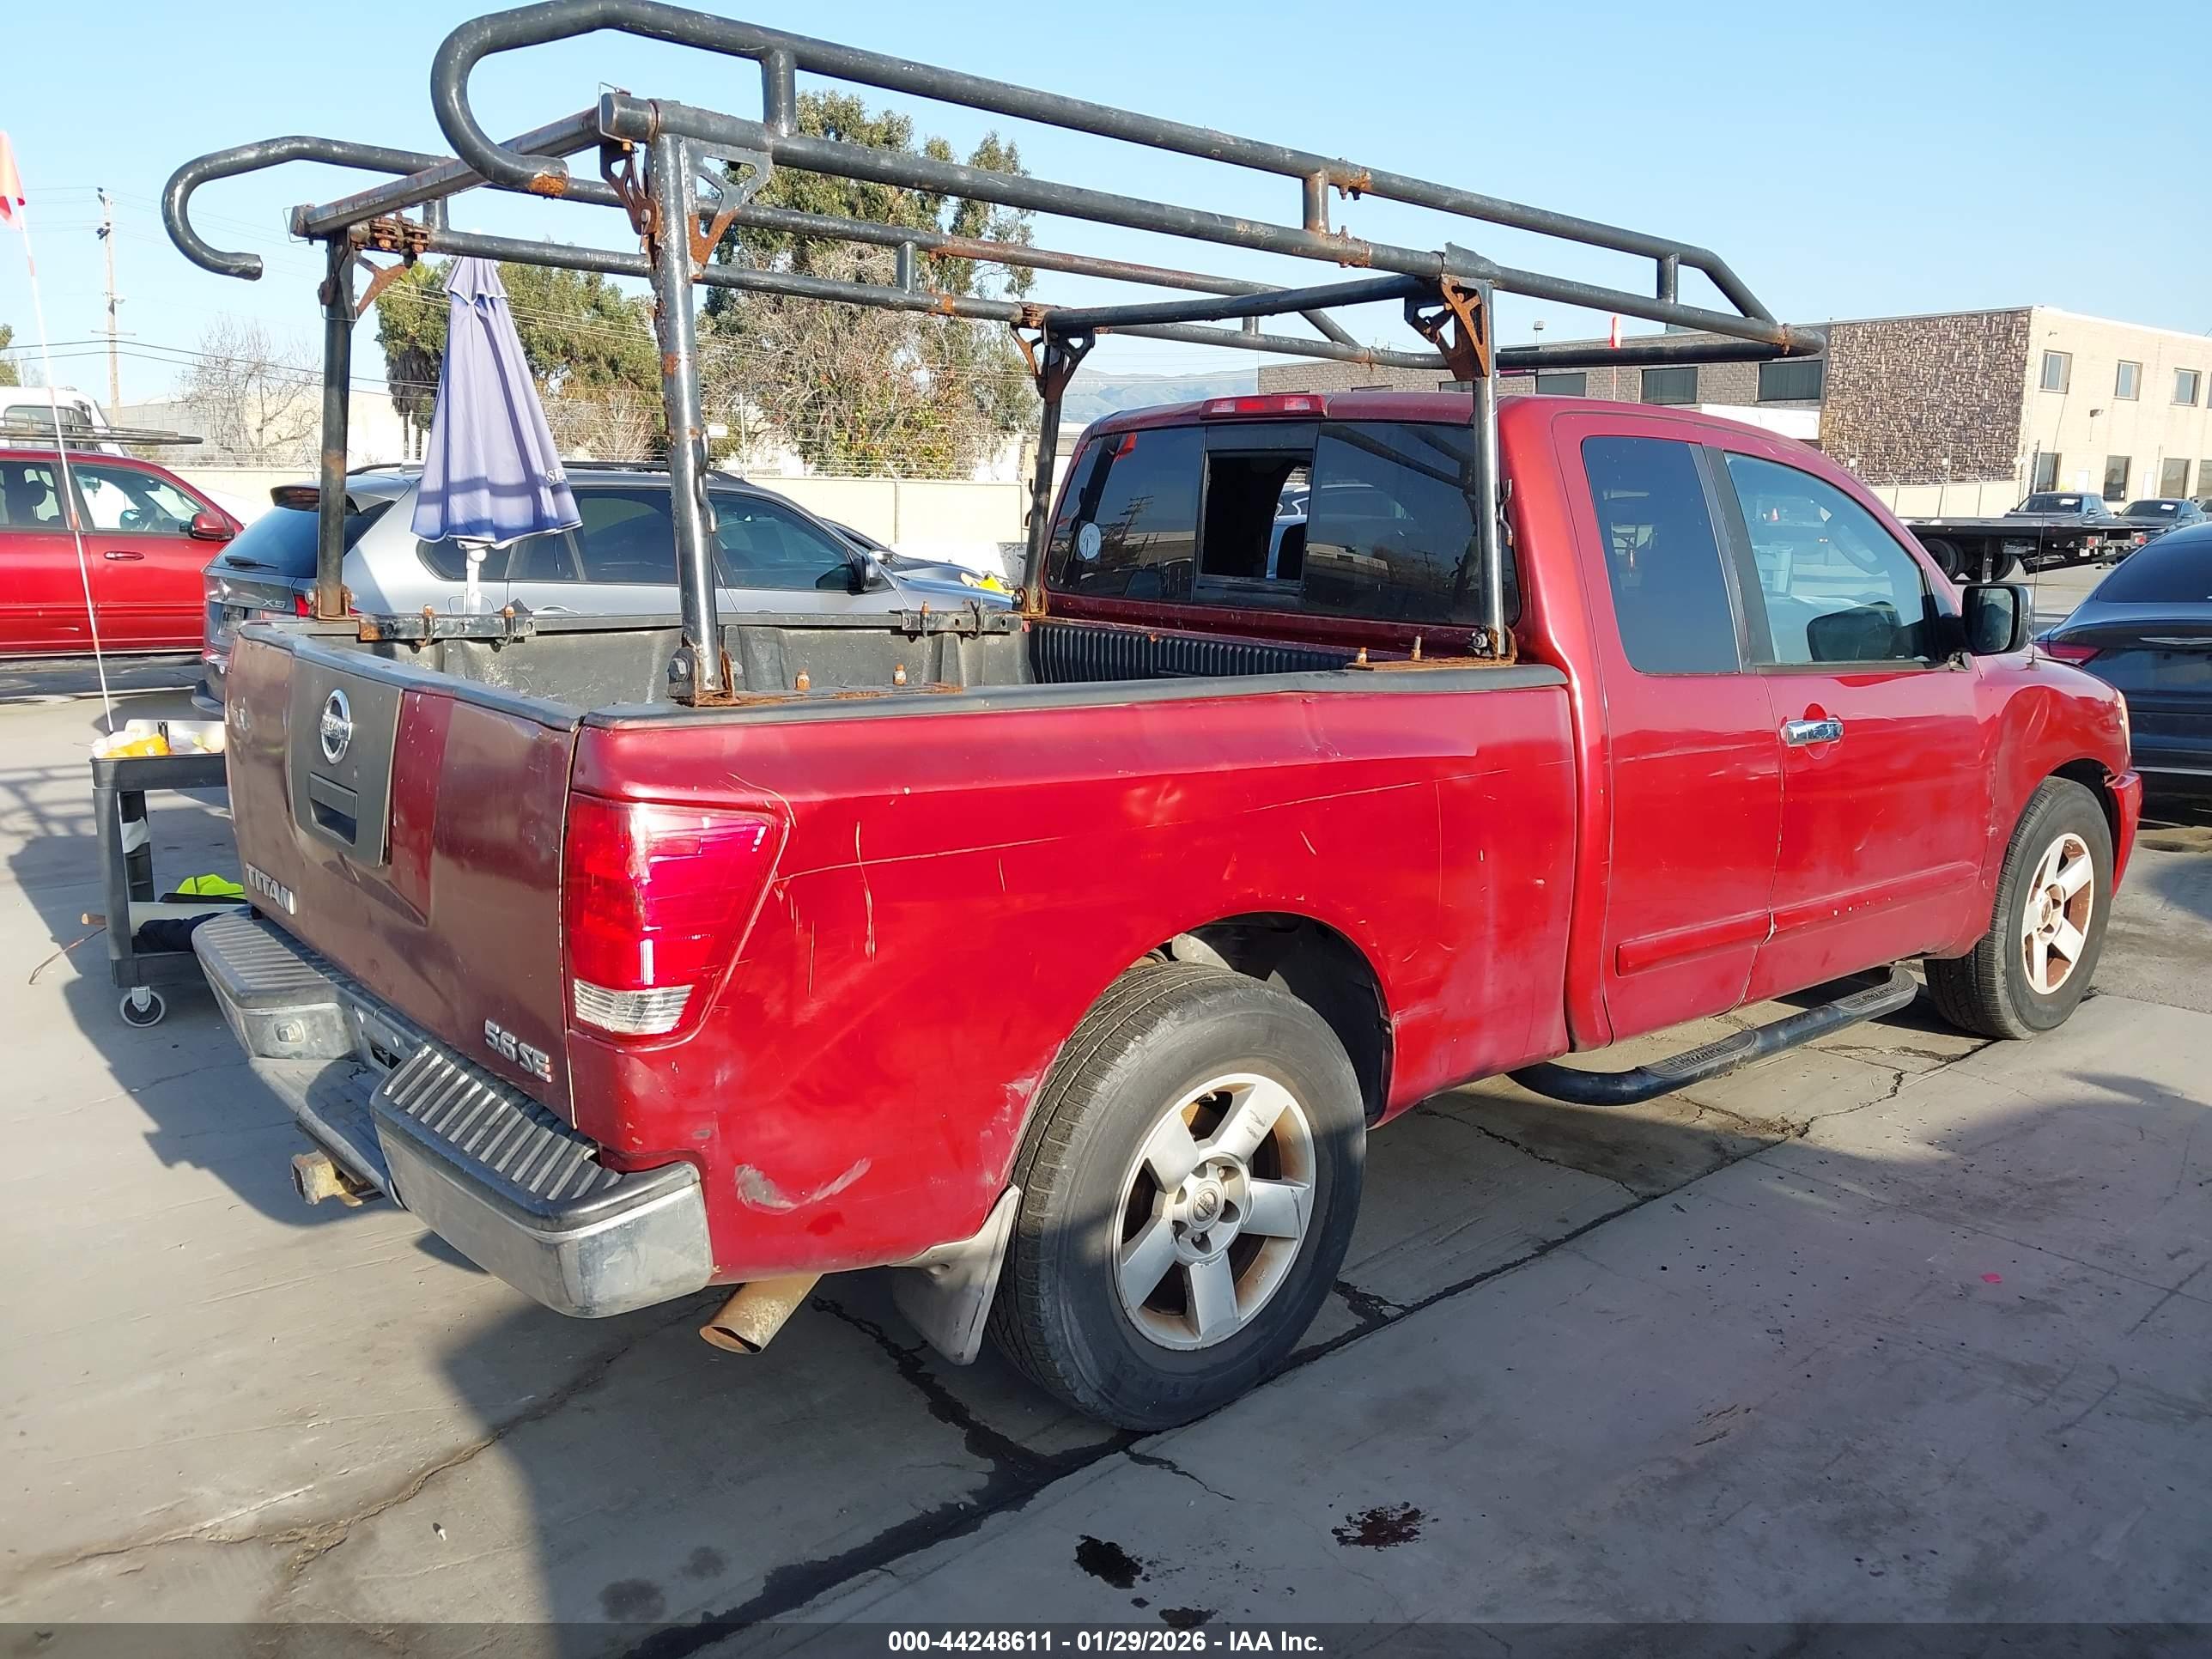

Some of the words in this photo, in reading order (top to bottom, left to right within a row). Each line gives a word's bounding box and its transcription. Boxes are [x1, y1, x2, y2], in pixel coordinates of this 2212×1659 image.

[261, 599, 287, 609] X5
[246, 862, 297, 915] TITAN
[518, 1042, 552, 1083] SE
